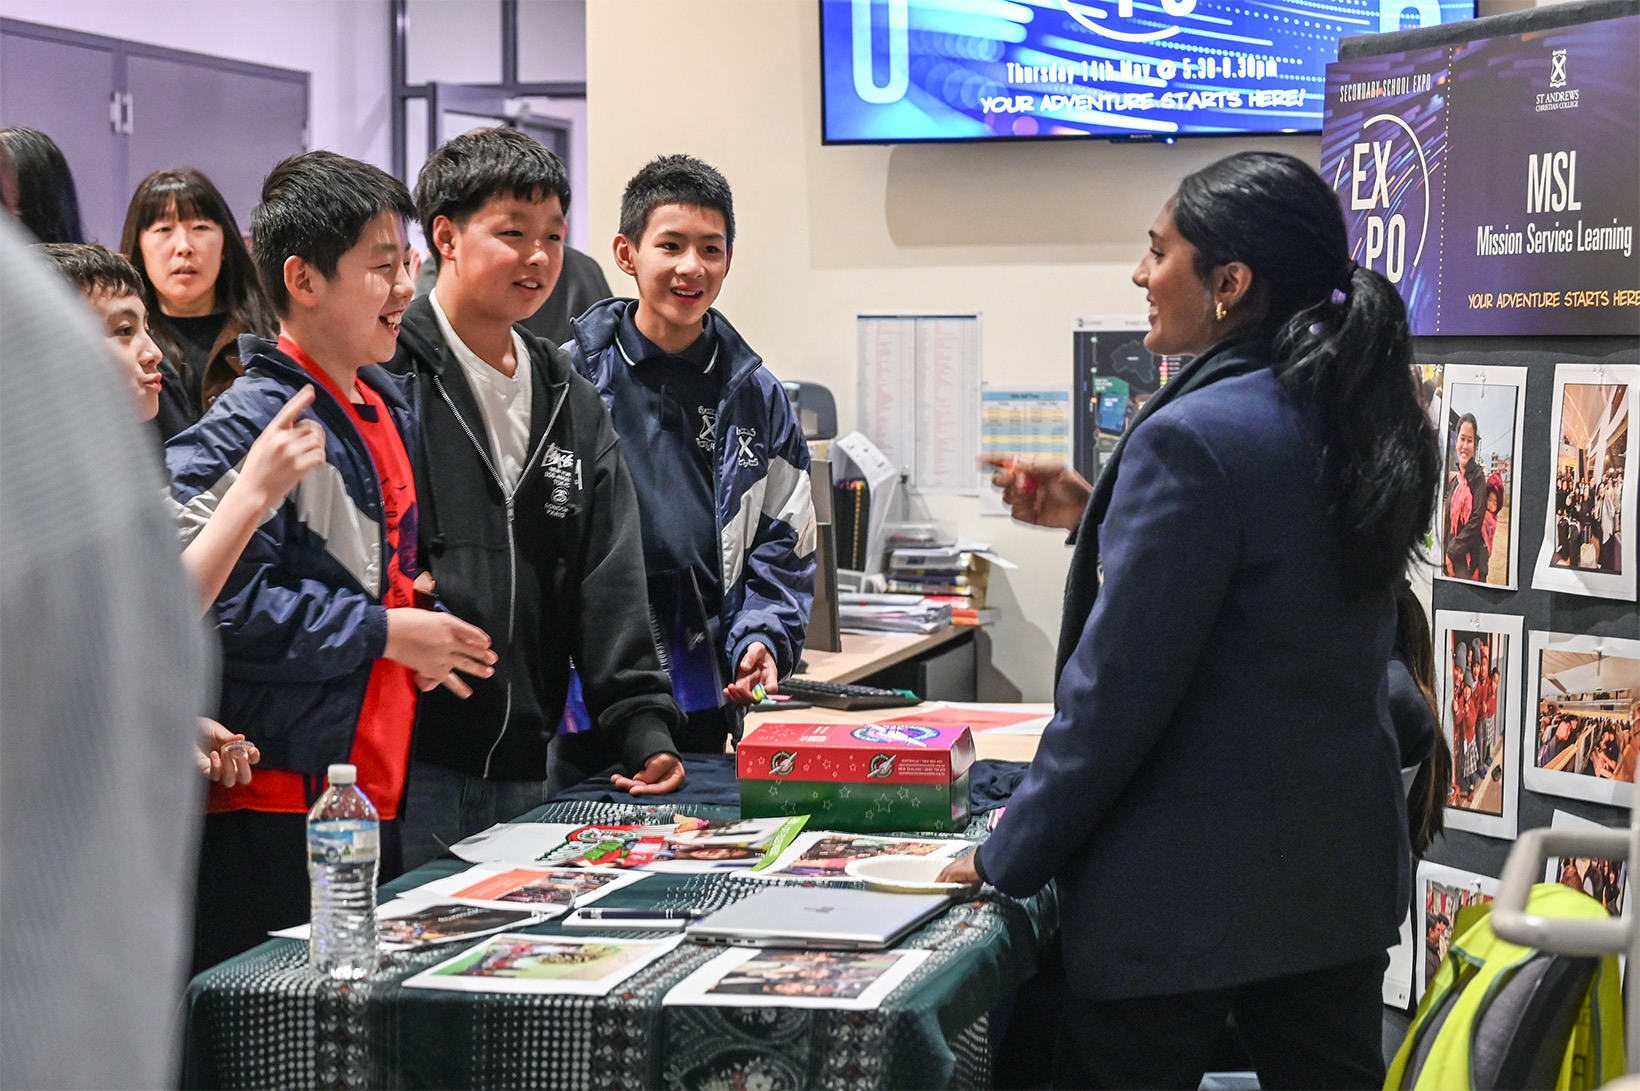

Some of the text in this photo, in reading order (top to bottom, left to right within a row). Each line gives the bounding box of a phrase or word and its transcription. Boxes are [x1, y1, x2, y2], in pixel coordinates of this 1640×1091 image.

[1006, 62, 1075, 84] Thursday
[1082, 60, 1114, 82] 14th
[1120, 60, 1150, 82] May
[1156, 59, 1177, 80] @
[980, 88, 1306, 114] YOUR ADVENTURE STARTS HERE!
[1340, 73, 1431, 103] SECONDARY SCHOOL EXPO
[1535, 89, 1580, 105] ST ANDREWS
[1535, 100, 1579, 112] CHRISTIAN COLLEGE
[1351, 140, 1393, 210] EX
[1526, 150, 1582, 214] MSL
[1365, 214, 1406, 284] PO
[1476, 217, 1633, 257] Mission Service Learning
[1468, 289, 1640, 309] YOUR ADVENTURE STARTS HERE
